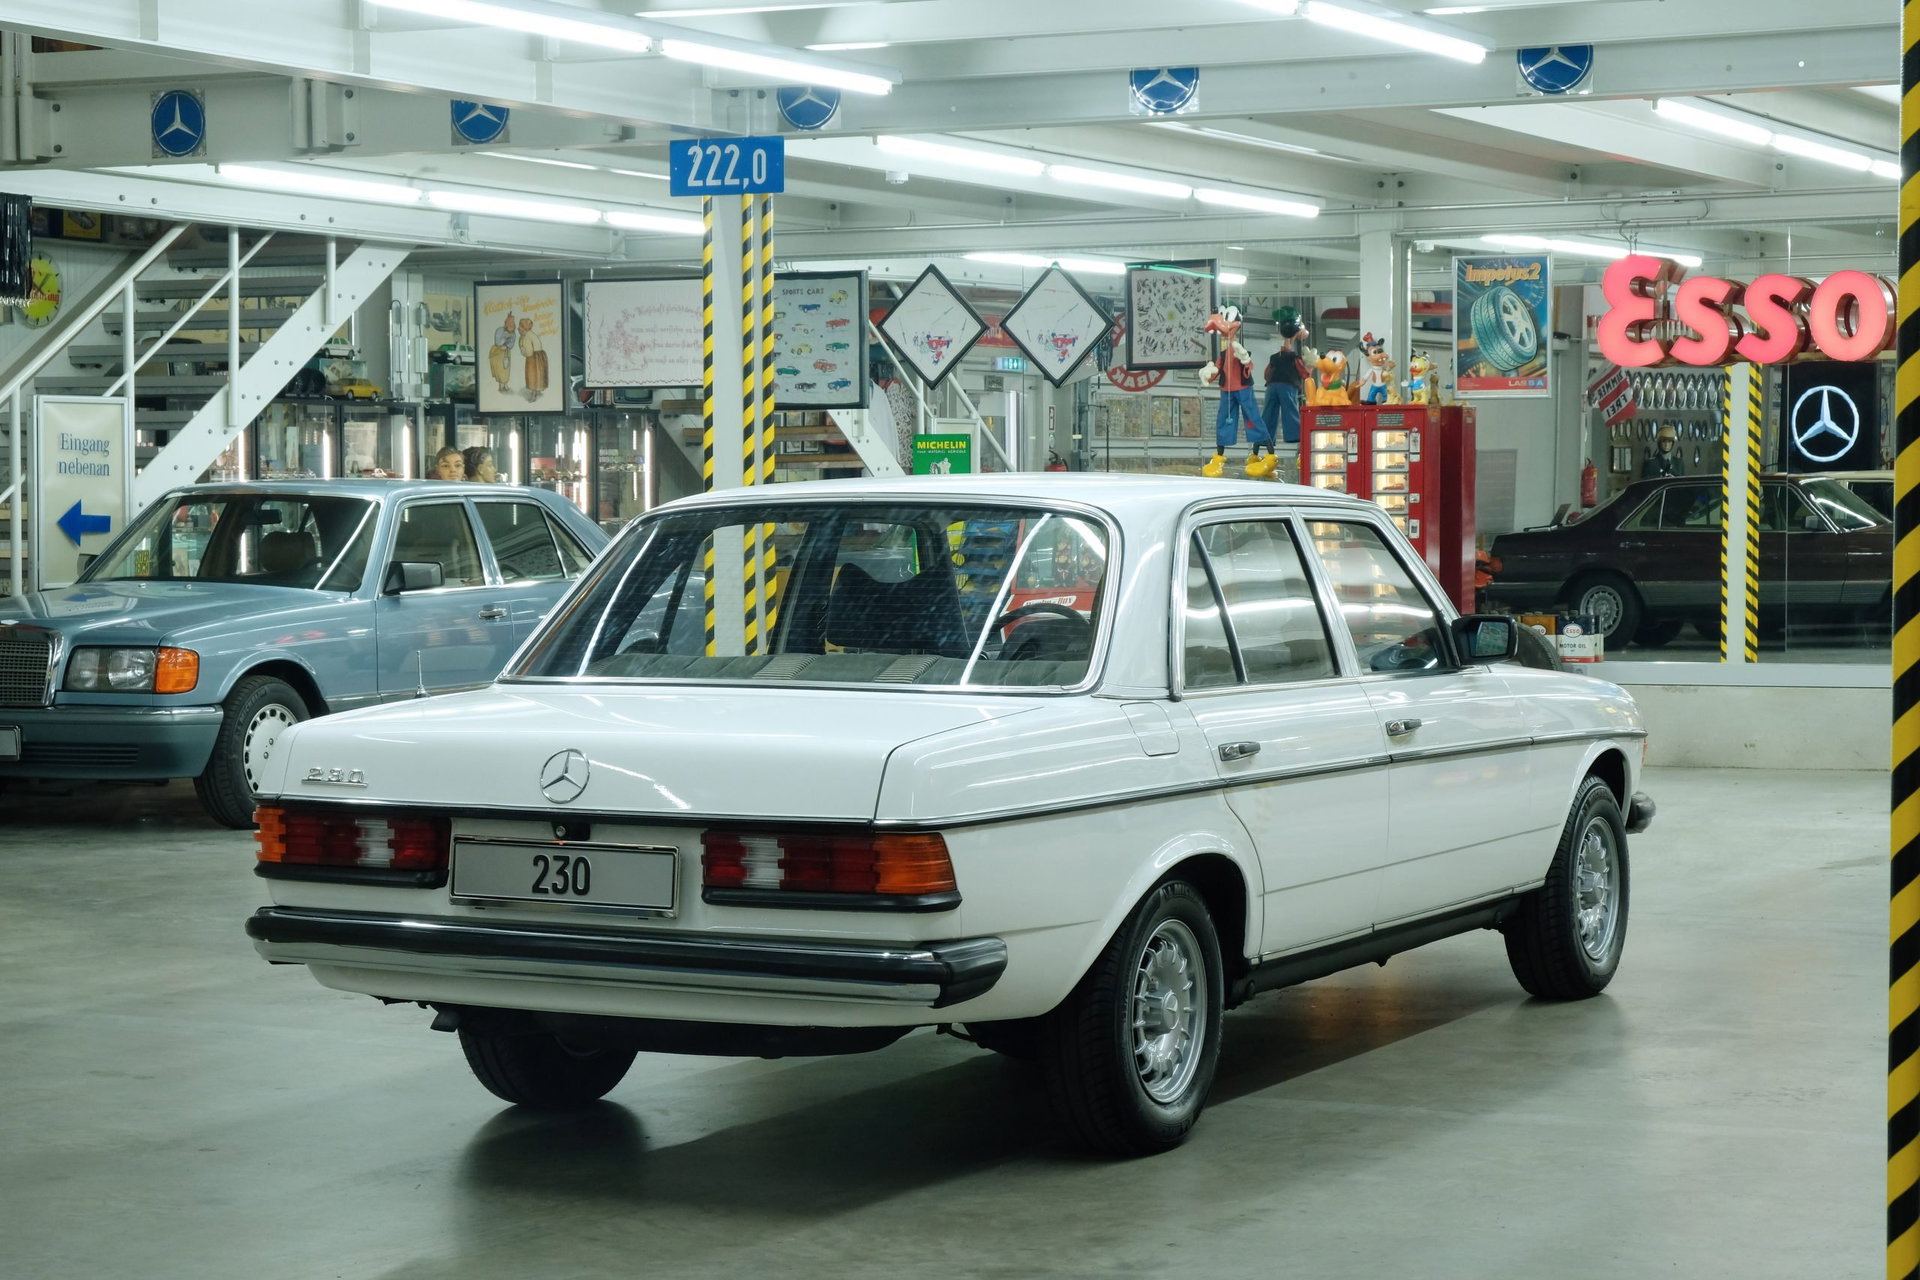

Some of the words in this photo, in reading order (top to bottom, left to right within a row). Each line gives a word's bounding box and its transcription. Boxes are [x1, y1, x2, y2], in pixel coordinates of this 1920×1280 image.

[687, 144, 767, 190] 222,0
[782, 288, 804, 296] SPORTS
[806, 287, 825, 295] CARS
[60, 432, 110, 457] Eingang
[917, 441, 966, 449] MICHELIN
[58, 458, 110, 477] nebenan
[307, 766, 364, 783] 230
[532, 854, 591, 896] 230
